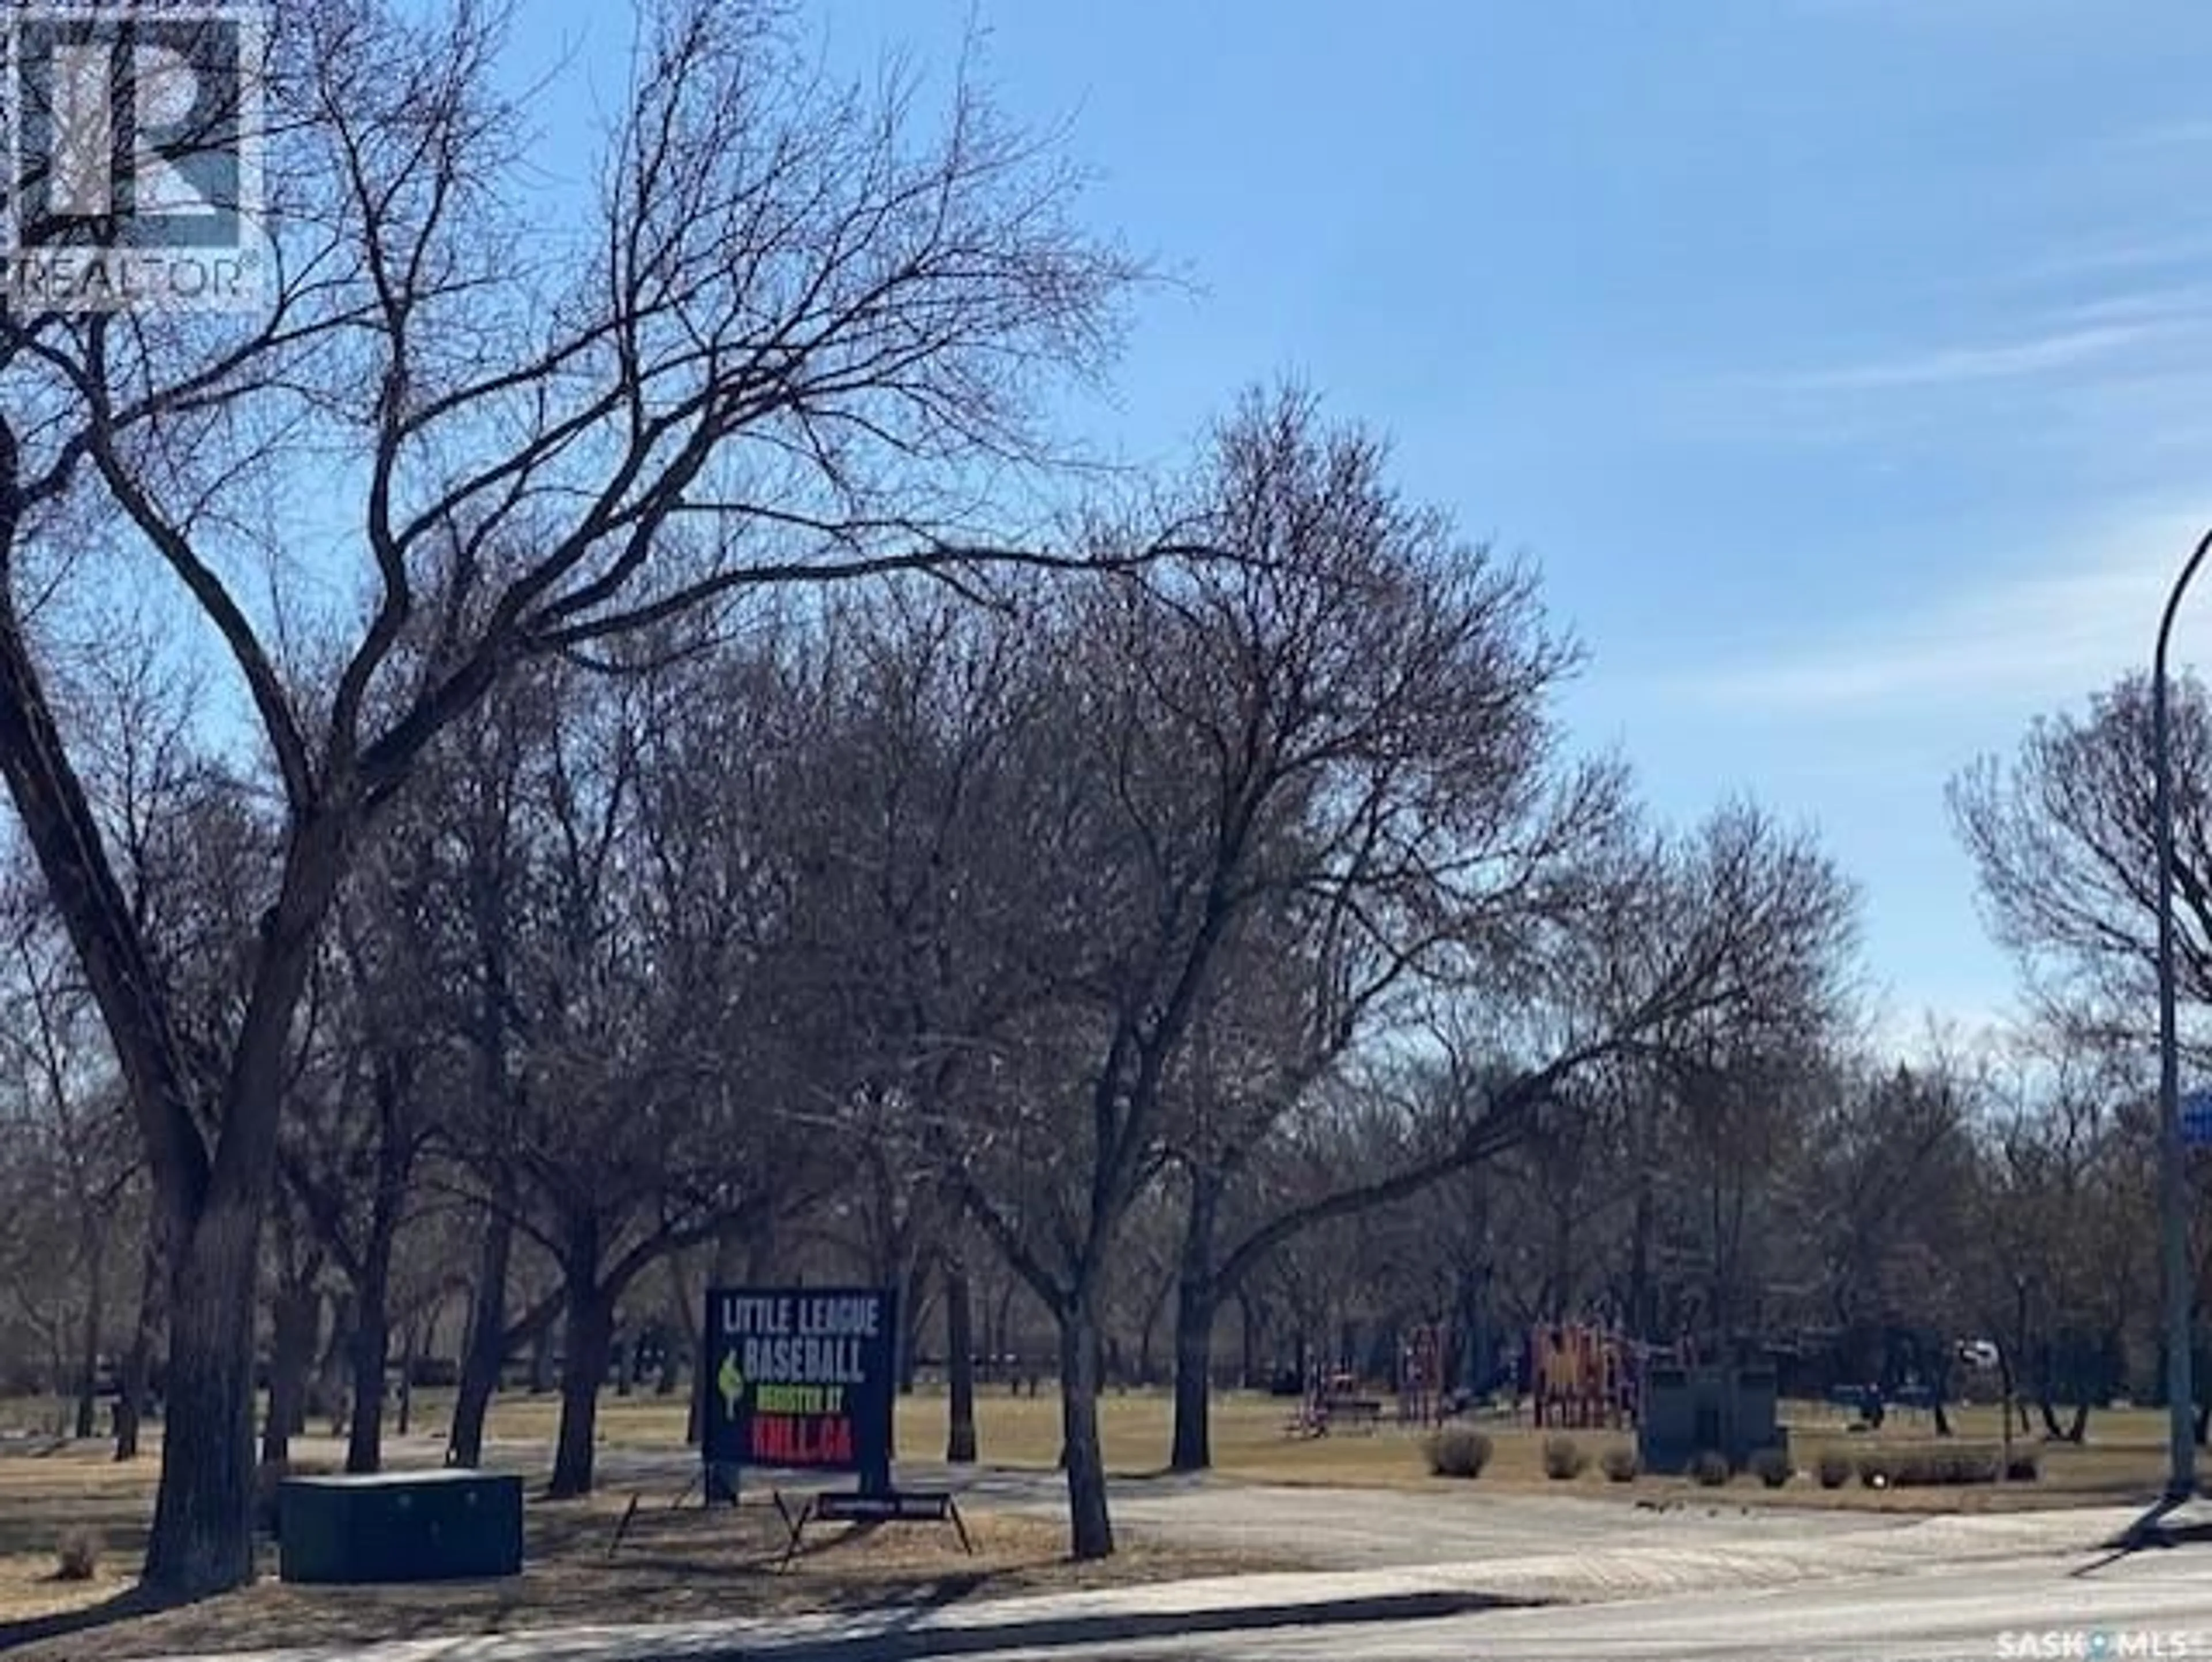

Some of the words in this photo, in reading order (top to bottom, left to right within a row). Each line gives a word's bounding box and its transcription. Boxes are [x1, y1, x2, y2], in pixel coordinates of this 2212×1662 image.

[724, 1298, 791, 1334] LITTLE
[799, 1297, 879, 1337] LEAGUE
[745, 1337, 865, 1382] BASEBALL
